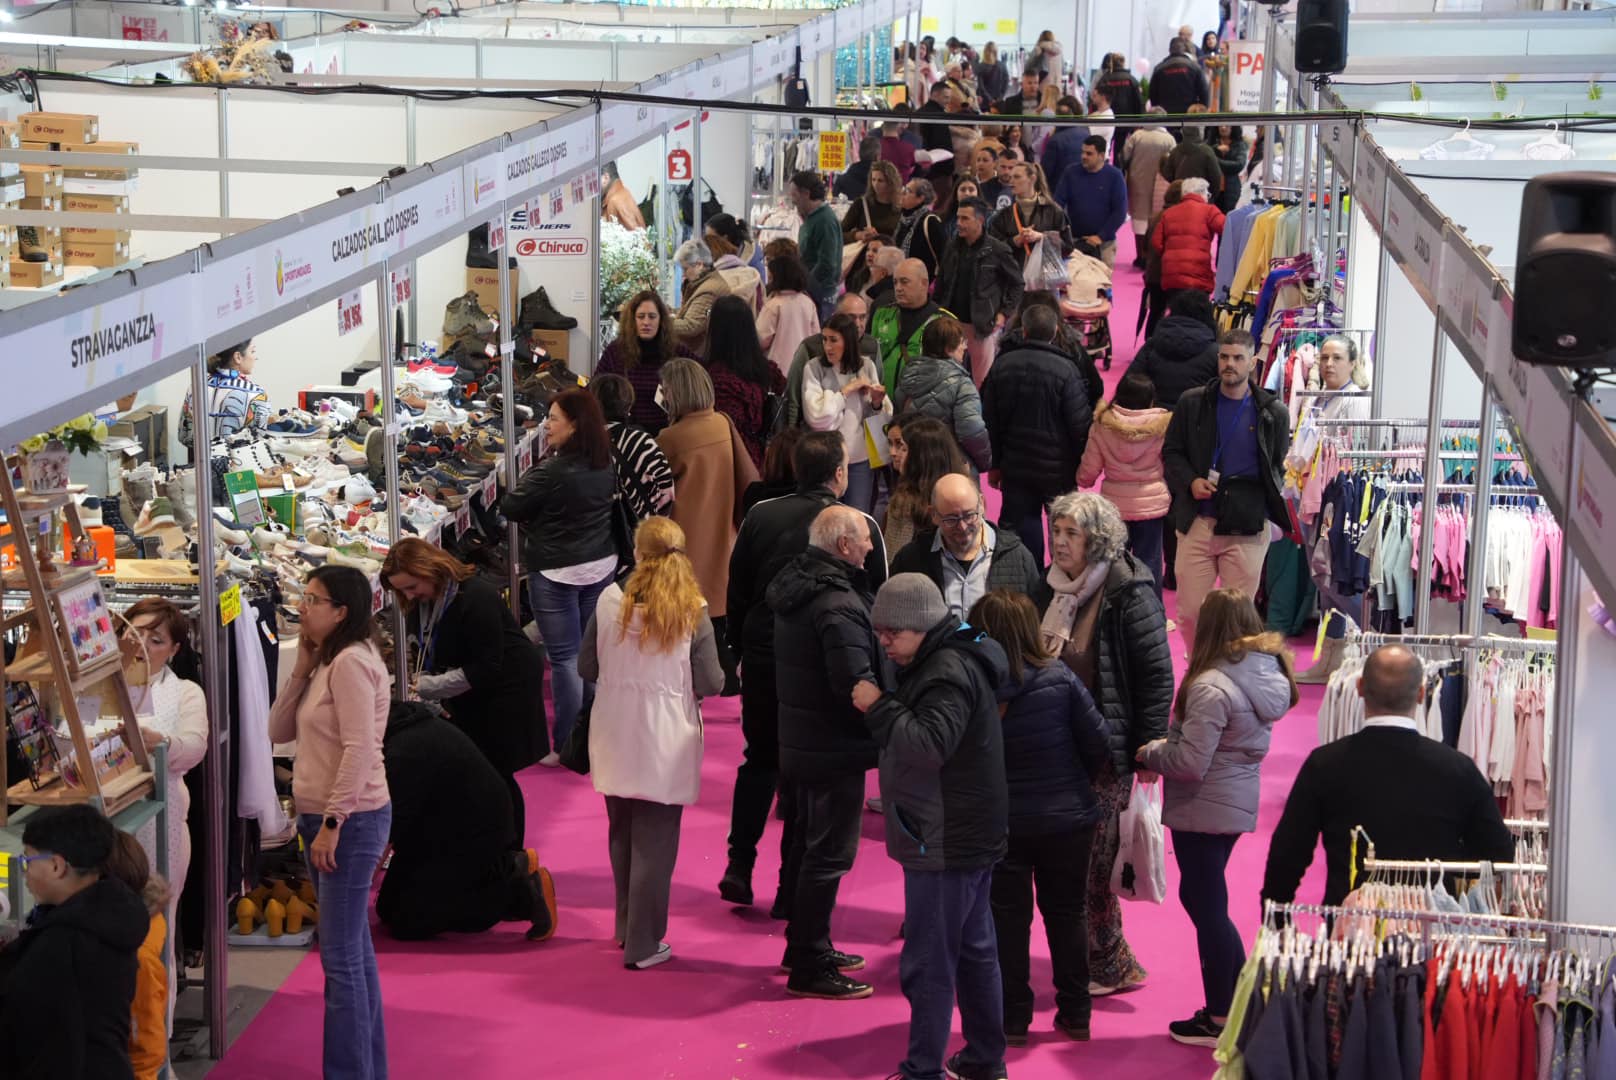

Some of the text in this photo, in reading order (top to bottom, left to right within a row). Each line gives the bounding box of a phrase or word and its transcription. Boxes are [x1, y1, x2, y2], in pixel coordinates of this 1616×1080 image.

[672, 157, 687, 178] 3
[332, 228, 368, 262] CALZADOS
[538, 241, 584, 253] Chiruca
[71, 312, 157, 369] STRAVAGANZZA
